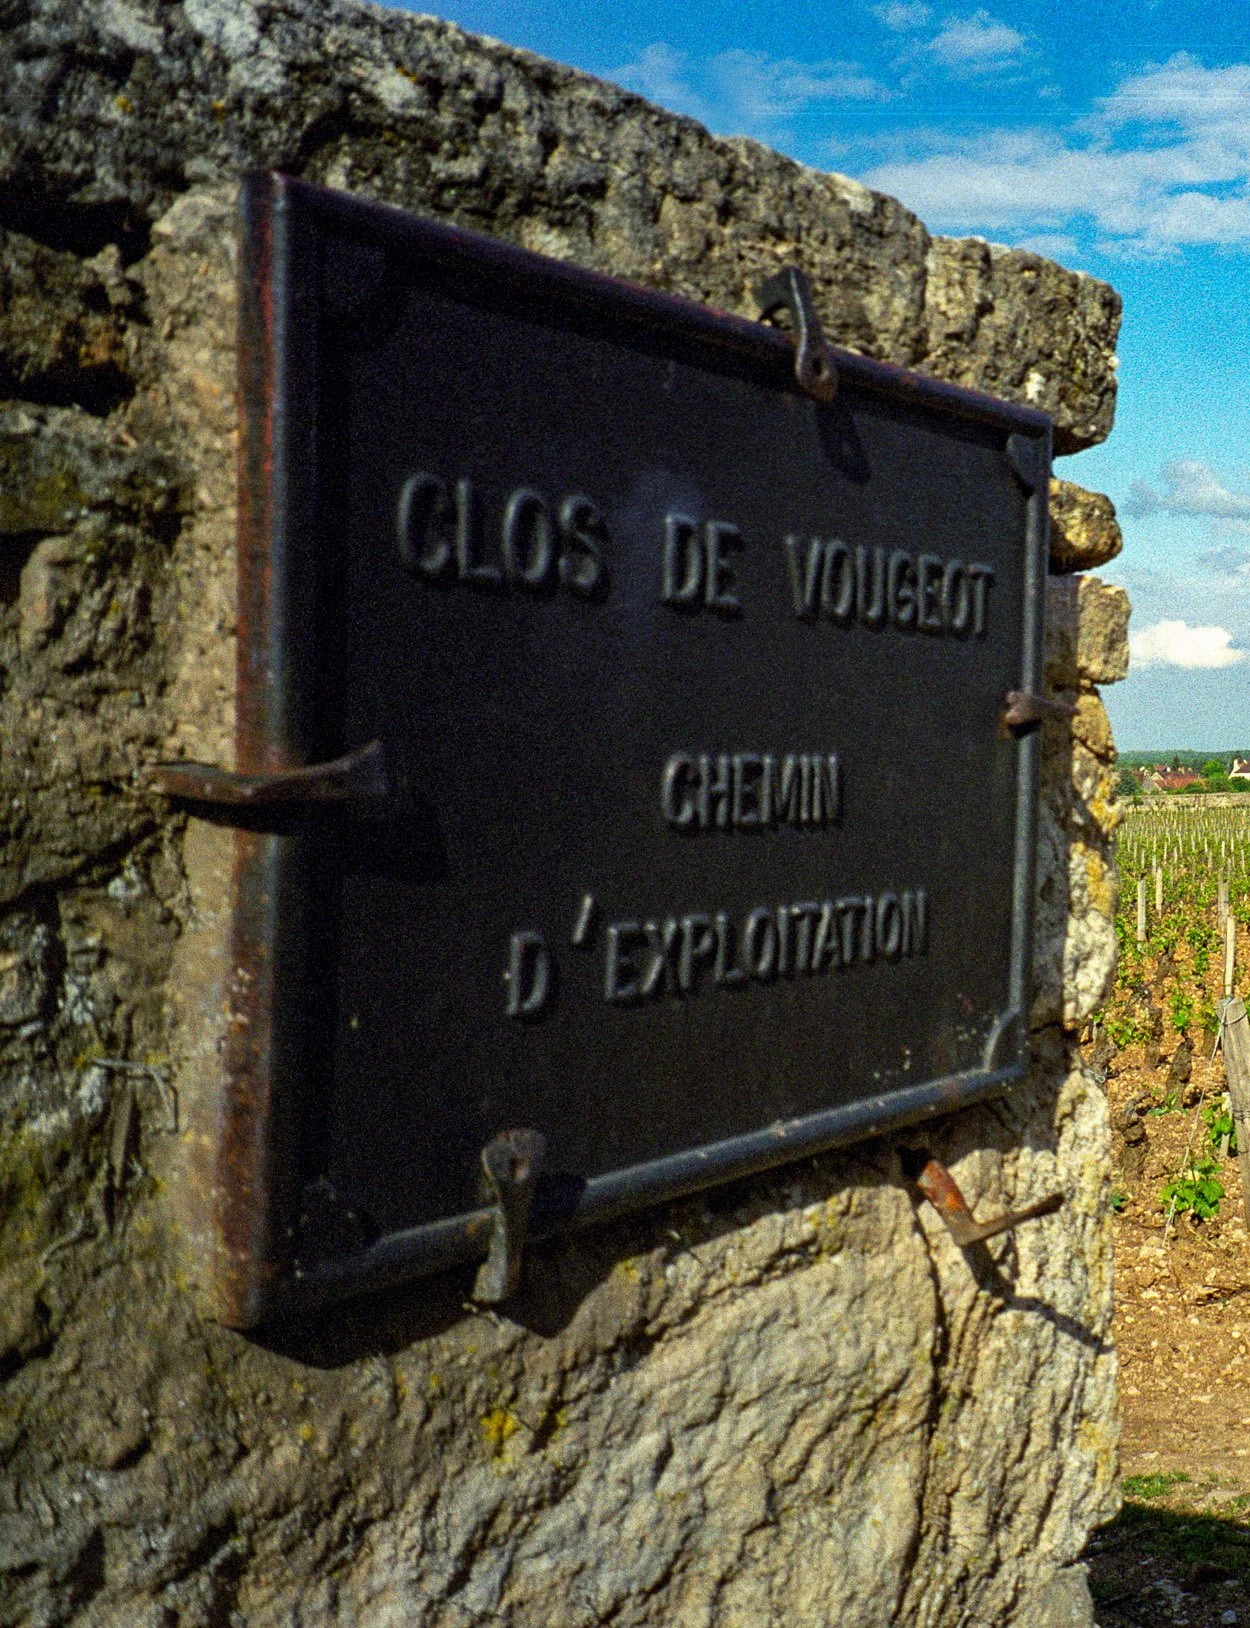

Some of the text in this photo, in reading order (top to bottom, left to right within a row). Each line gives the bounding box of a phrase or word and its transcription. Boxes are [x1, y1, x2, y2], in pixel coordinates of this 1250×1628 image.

[397, 471, 995, 633] CLOS DE VOUGEOT
[661, 752, 841, 827] CHEMIN
